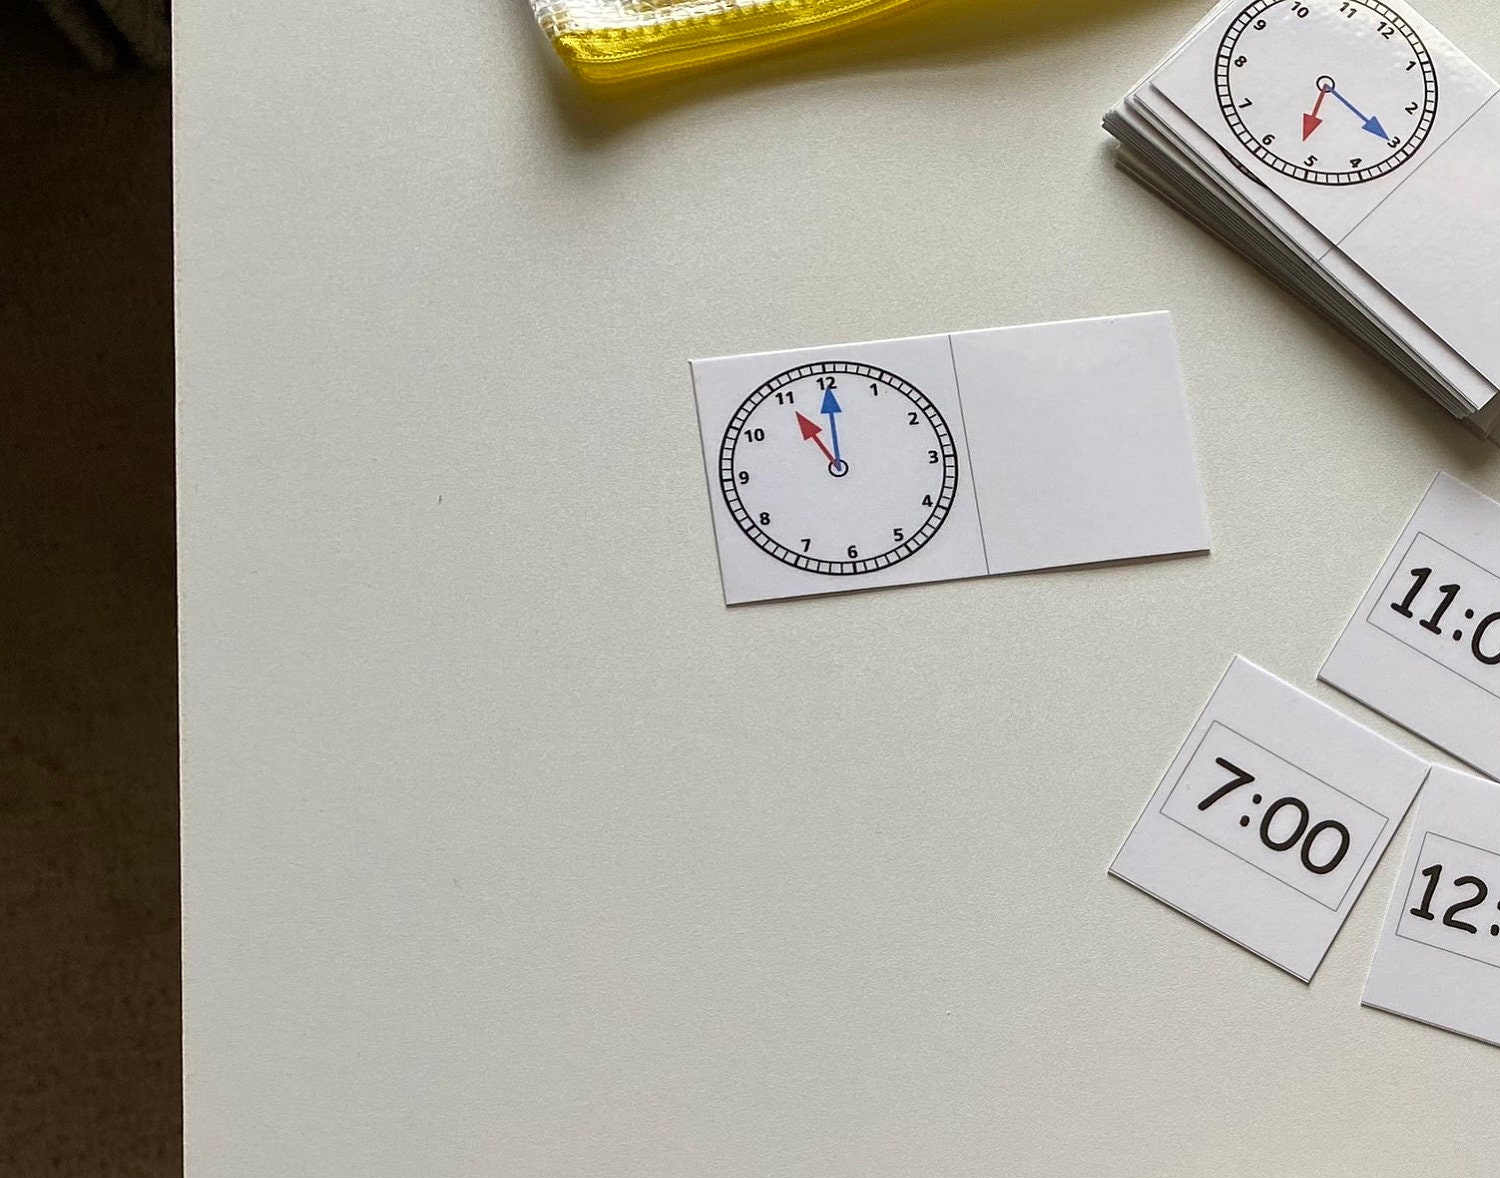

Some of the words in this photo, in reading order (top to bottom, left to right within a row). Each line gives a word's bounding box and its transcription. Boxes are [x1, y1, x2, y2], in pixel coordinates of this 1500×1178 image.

[1290, 1, 1310, 19] 10
[1339, 1, 1357, 19] 11
[1253, 19, 1267, 31] 9
[1376, 21, 1395, 40] 12
[1234, 55, 1248, 68] 8
[1405, 60, 1417, 72] 1
[1238, 97, 1253, 109] 7
[1404, 101, 1419, 116] 2
[1261, 134, 1276, 146] 6
[1385, 134, 1402, 149] 3
[1303, 154, 1318, 167] 5
[1349, 157, 1363, 169] 4
[815, 376, 838, 391] 12
[869, 382, 879, 397] 1
[774, 390, 795, 406] 11
[907, 411, 920, 426] 2
[743, 428, 765, 443] 10
[927, 450, 939, 465] 3
[738, 470, 750, 485] 9
[921, 494, 934, 508] 4
[759, 511, 771, 526] 8
[893, 527, 905, 542] 5
[800, 538, 811, 553] 7
[847, 544, 859, 559] 6
[1198, 757, 1350, 874] 7:00
